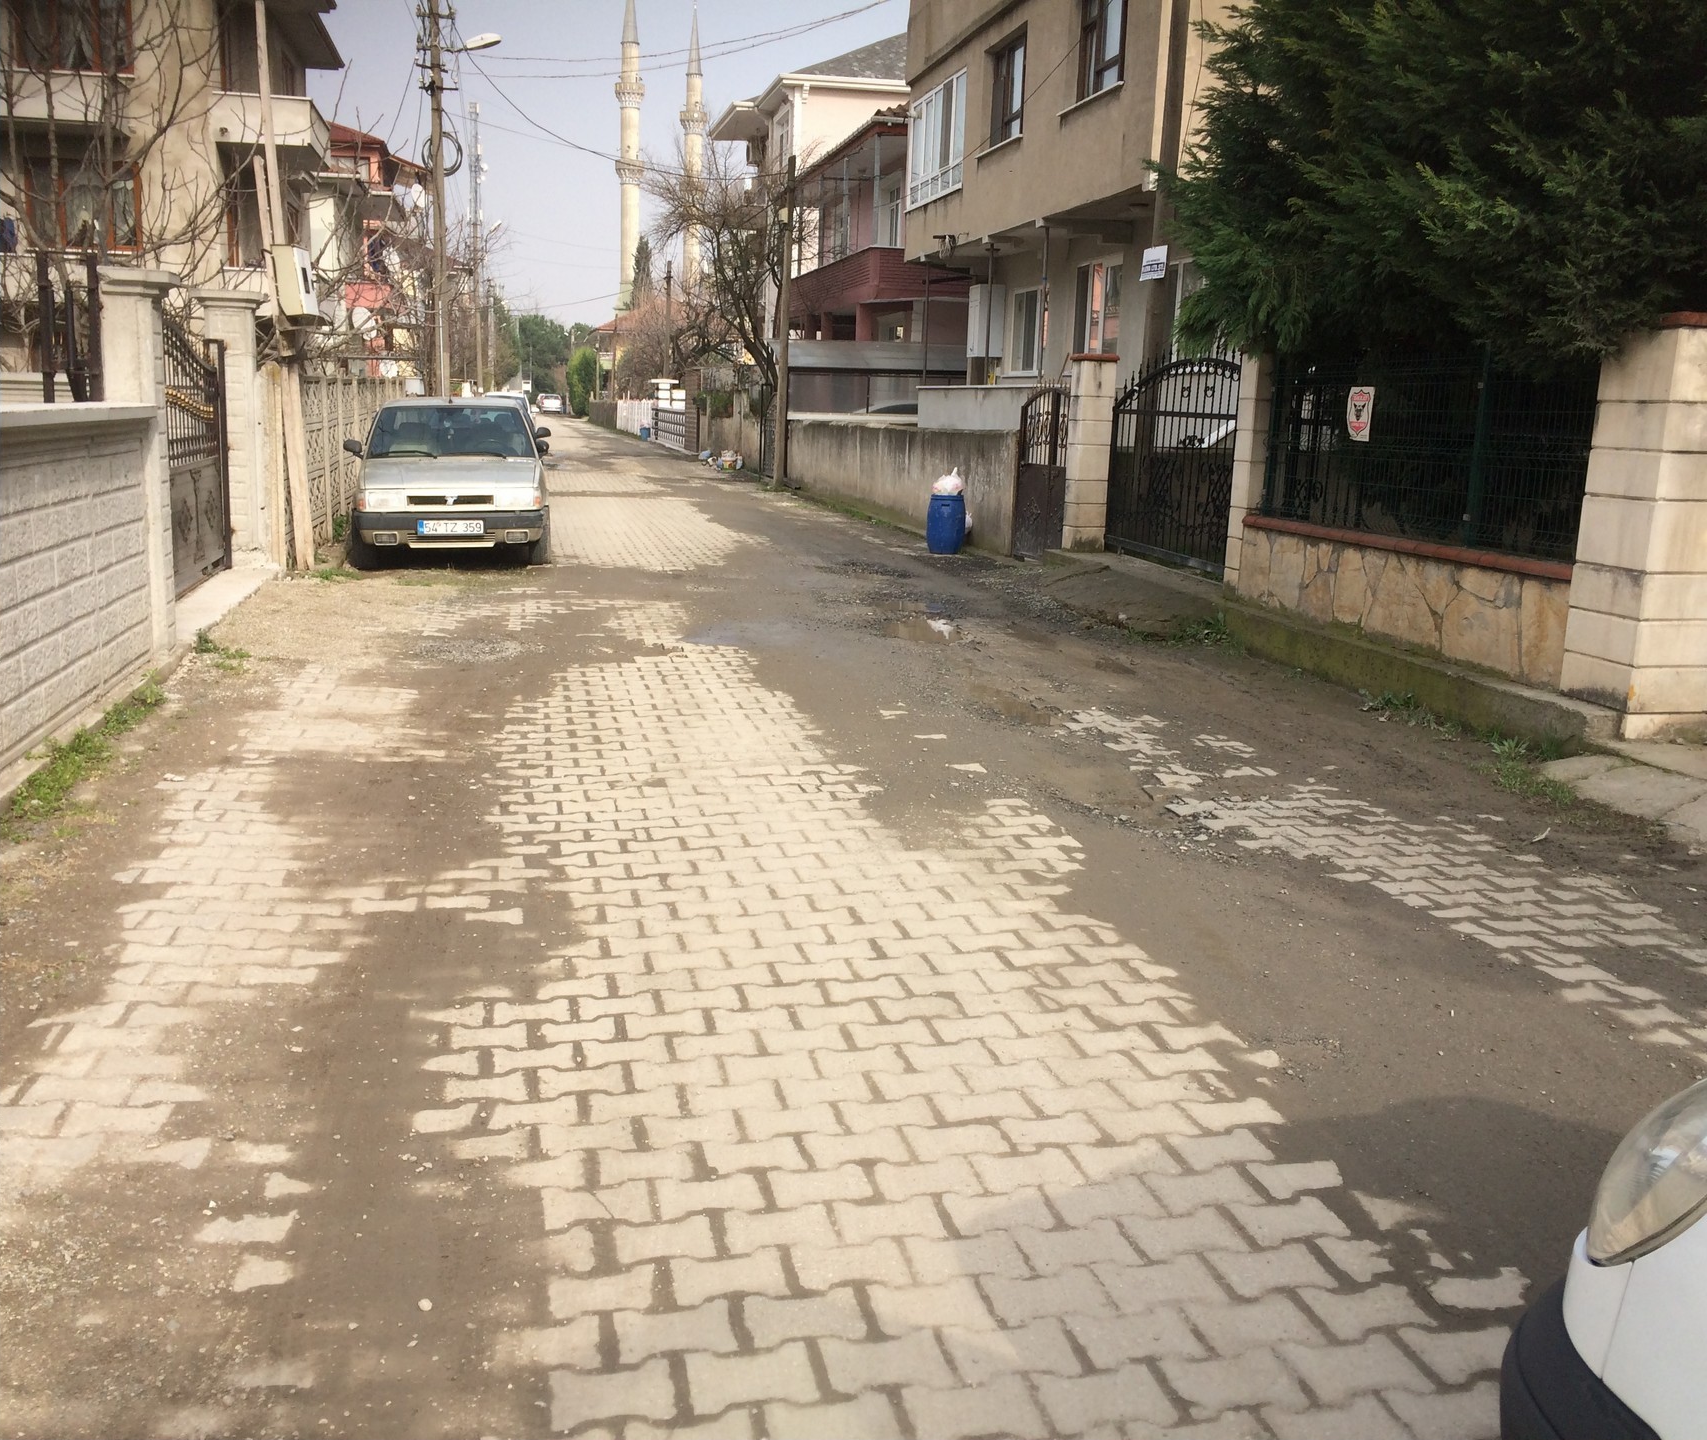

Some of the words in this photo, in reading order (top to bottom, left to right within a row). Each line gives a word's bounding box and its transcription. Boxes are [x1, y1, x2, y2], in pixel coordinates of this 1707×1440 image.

[424, 522, 438, 533] 54
[444, 522, 458, 533] TZ
[462, 522, 482, 533] 359
